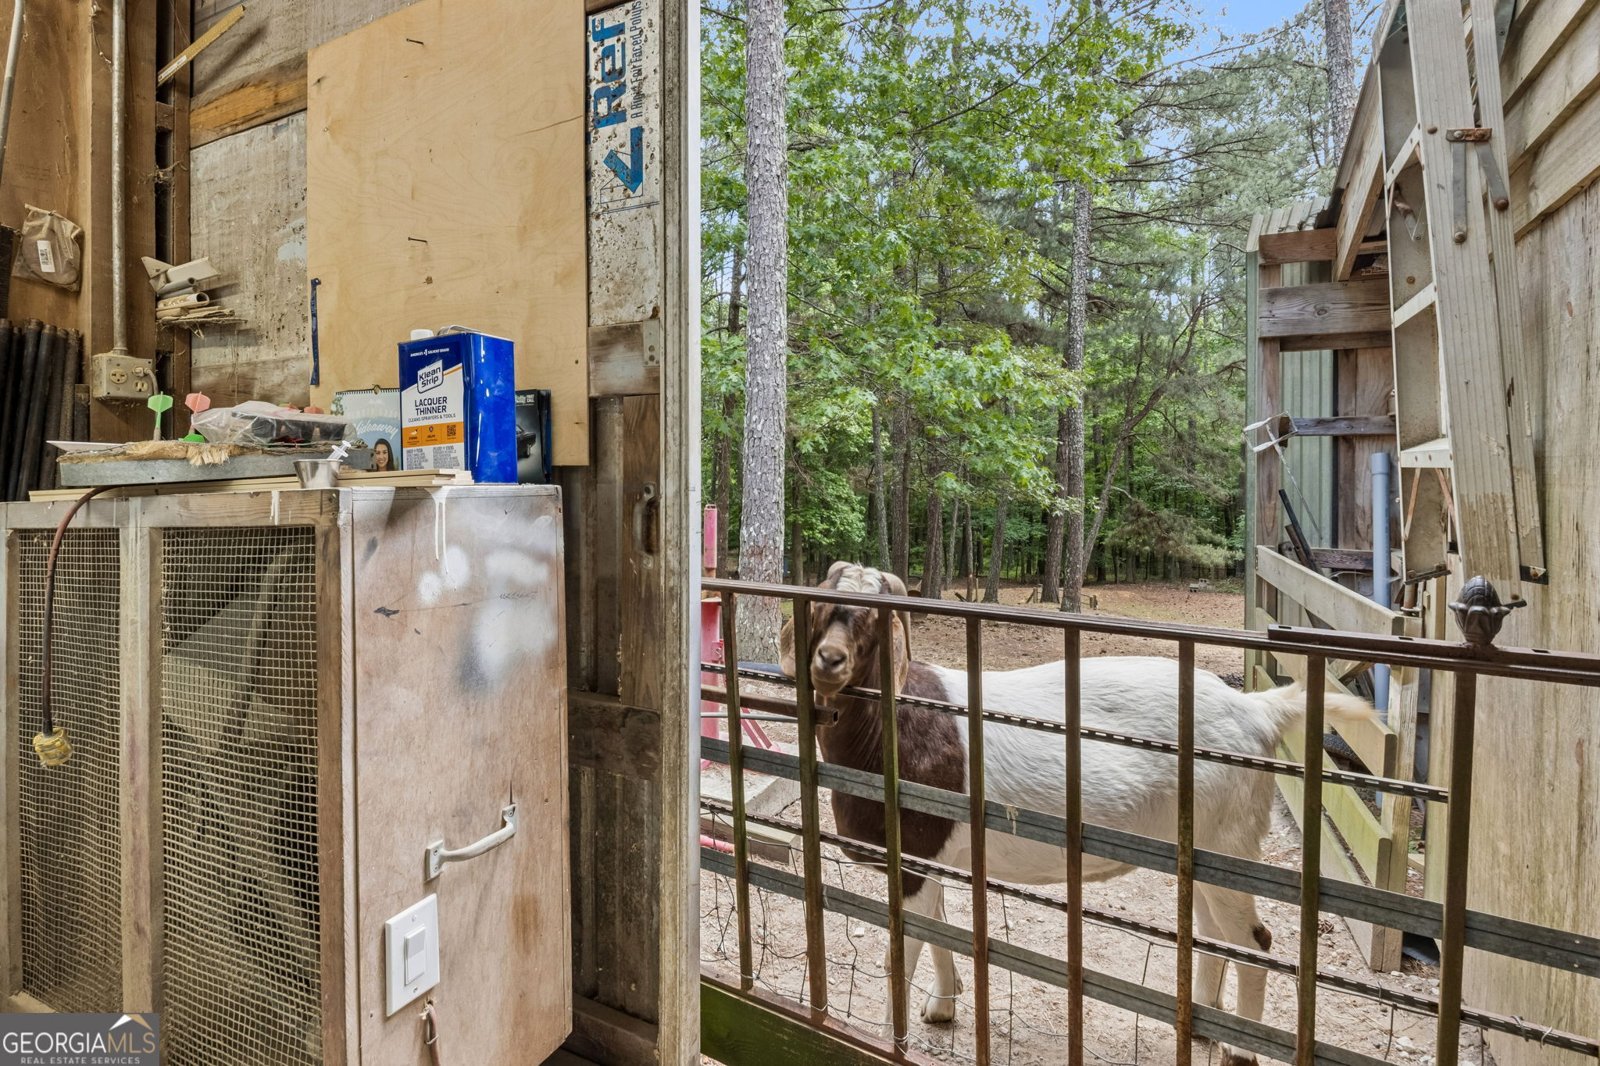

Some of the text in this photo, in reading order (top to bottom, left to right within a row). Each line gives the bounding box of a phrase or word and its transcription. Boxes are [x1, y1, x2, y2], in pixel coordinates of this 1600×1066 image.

[630, 35, 643, 64] Faced
[592, 17, 627, 129] Ref
[630, 111, 643, 119] A
[418, 366, 441, 381] Klean
[421, 375, 439, 388] Strip
[414, 396, 448, 408] LACQUER
[415, 405, 447, 416] THINNER
